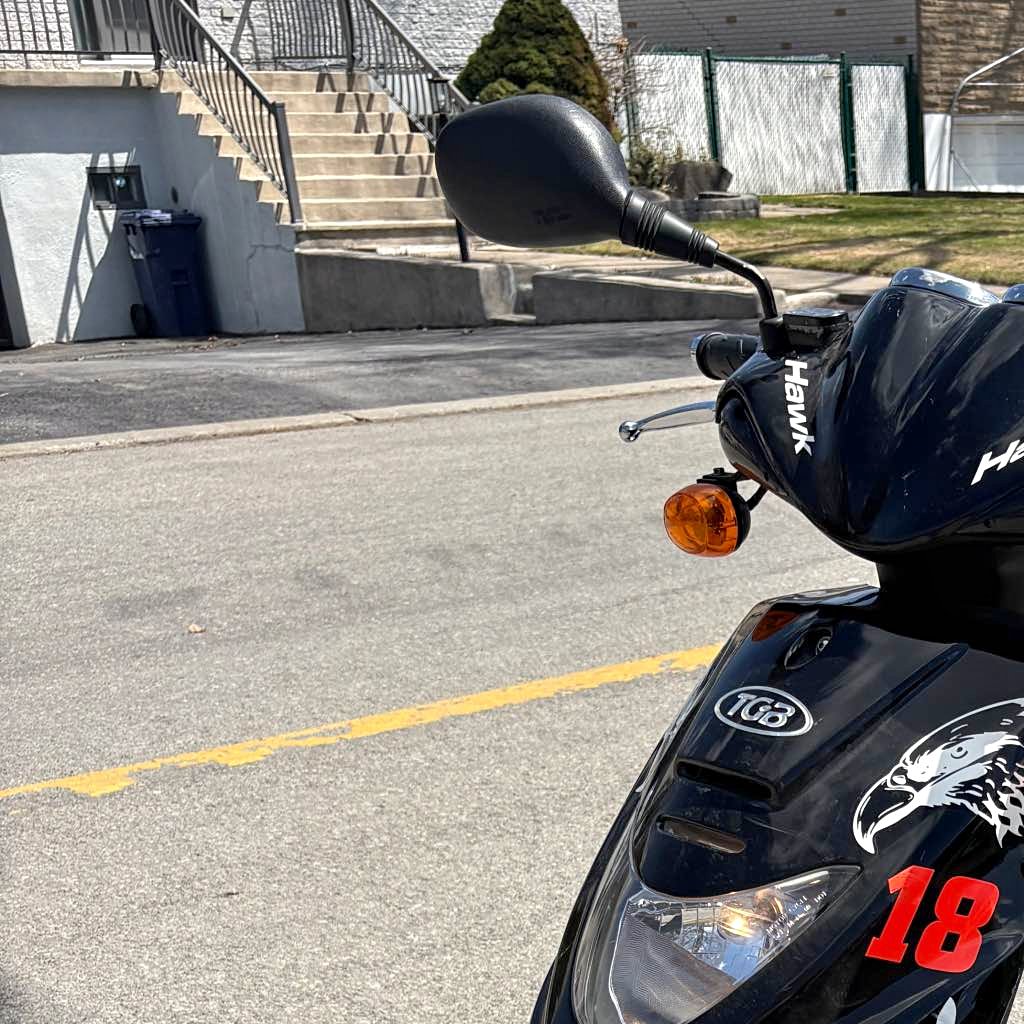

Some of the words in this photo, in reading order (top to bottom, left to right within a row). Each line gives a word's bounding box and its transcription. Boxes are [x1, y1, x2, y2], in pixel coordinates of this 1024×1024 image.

[784, 359, 815, 456] Hawk
[727, 692, 796, 728] TGB
[865, 865, 1000, 974] 18
